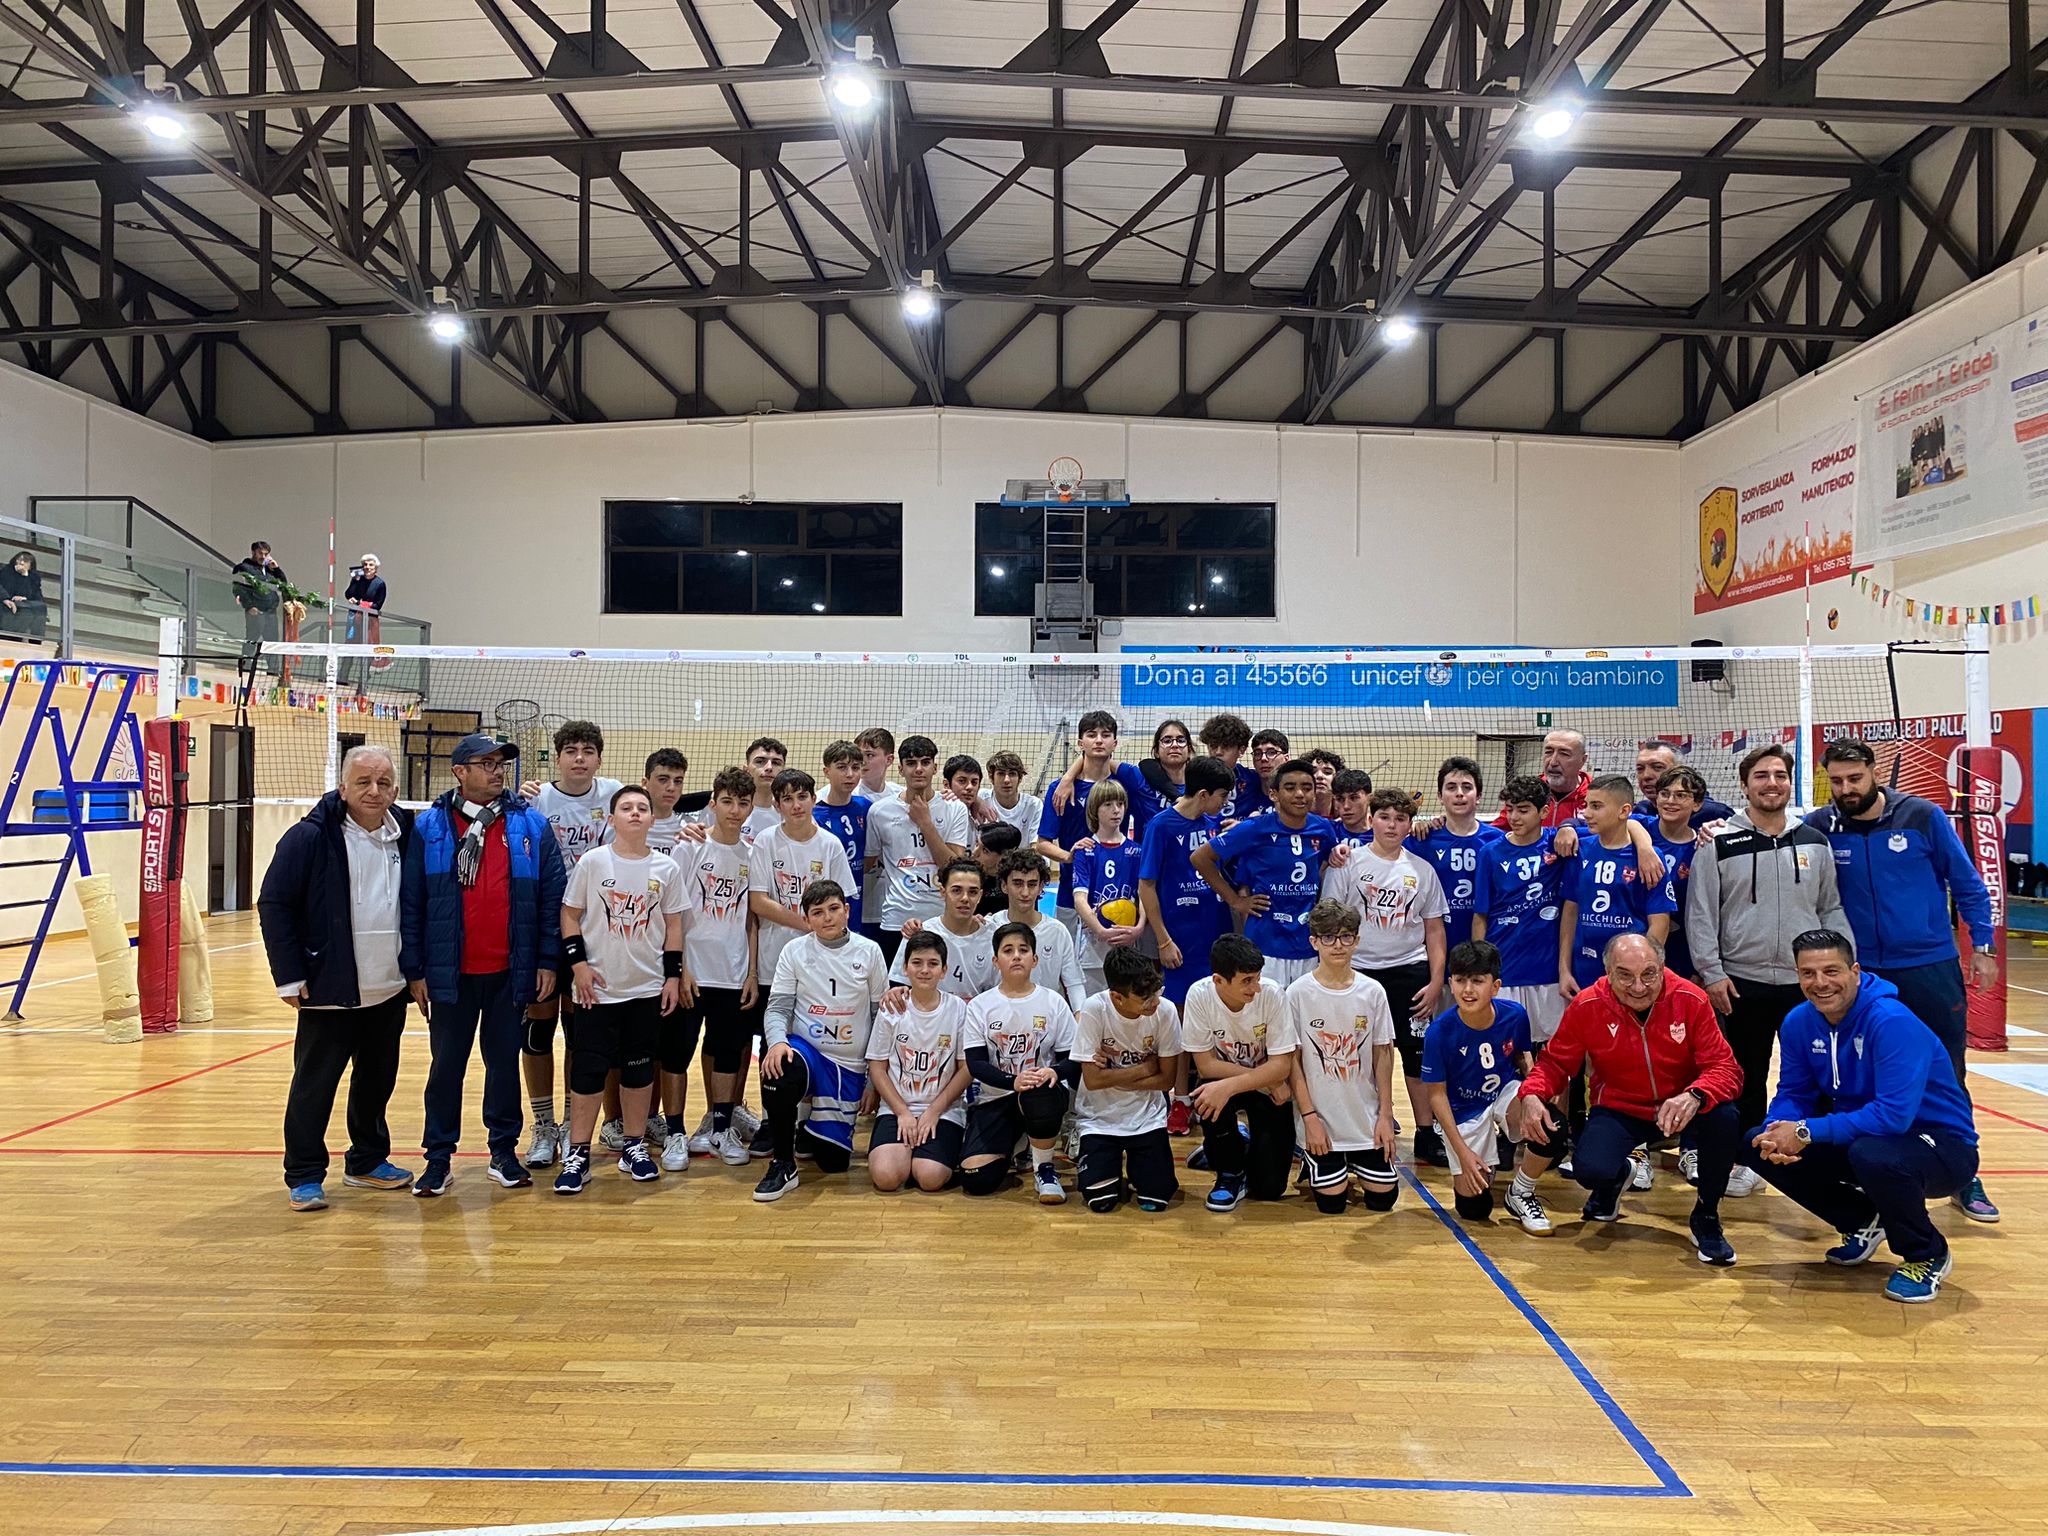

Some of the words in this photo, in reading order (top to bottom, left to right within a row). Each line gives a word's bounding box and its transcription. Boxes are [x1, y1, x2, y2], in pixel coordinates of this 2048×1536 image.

[1811, 444, 1856, 474] FORMAZIO
[1741, 472, 1795, 503] SORVEGLIANZA
[1741, 499, 1784, 525] PORTIERATO
[1134, 664, 1205, 686] Dona
[1214, 664, 1237, 686] al
[1245, 664, 1328, 687] 45566
[1351, 663, 1422, 687] unicef
[1467, 669, 1504, 691] per
[1511, 665, 1559, 691] ogni
[1567, 665, 1665, 687] bambino
[1823, 724, 1860, 743] SCUOLA
[1861, 719, 1913, 742] FEDERALE
[1915, 717, 1928, 739] DI
[10, 771, 20, 785] 2
[567, 826, 589, 846] 24
[840, 815, 854, 836] 3
[910, 832, 926, 848] 13
[1290, 834, 1303, 856] 9
[1104, 859, 1116, 879] 6
[1450, 848, 1476, 872] 56
[1516, 855, 1542, 881] 37
[1594, 860, 1617, 884] 18
[714, 878, 734, 898] 25
[1376, 888, 1398, 908] 22
[625, 895, 636, 915] 4
[953, 965, 963, 983] 4
[828, 978, 837, 997] 1
[1009, 1034, 1027, 1055] 23
[914, 1050, 930, 1072] 10
[1478, 1042, 1495, 1070] 8
